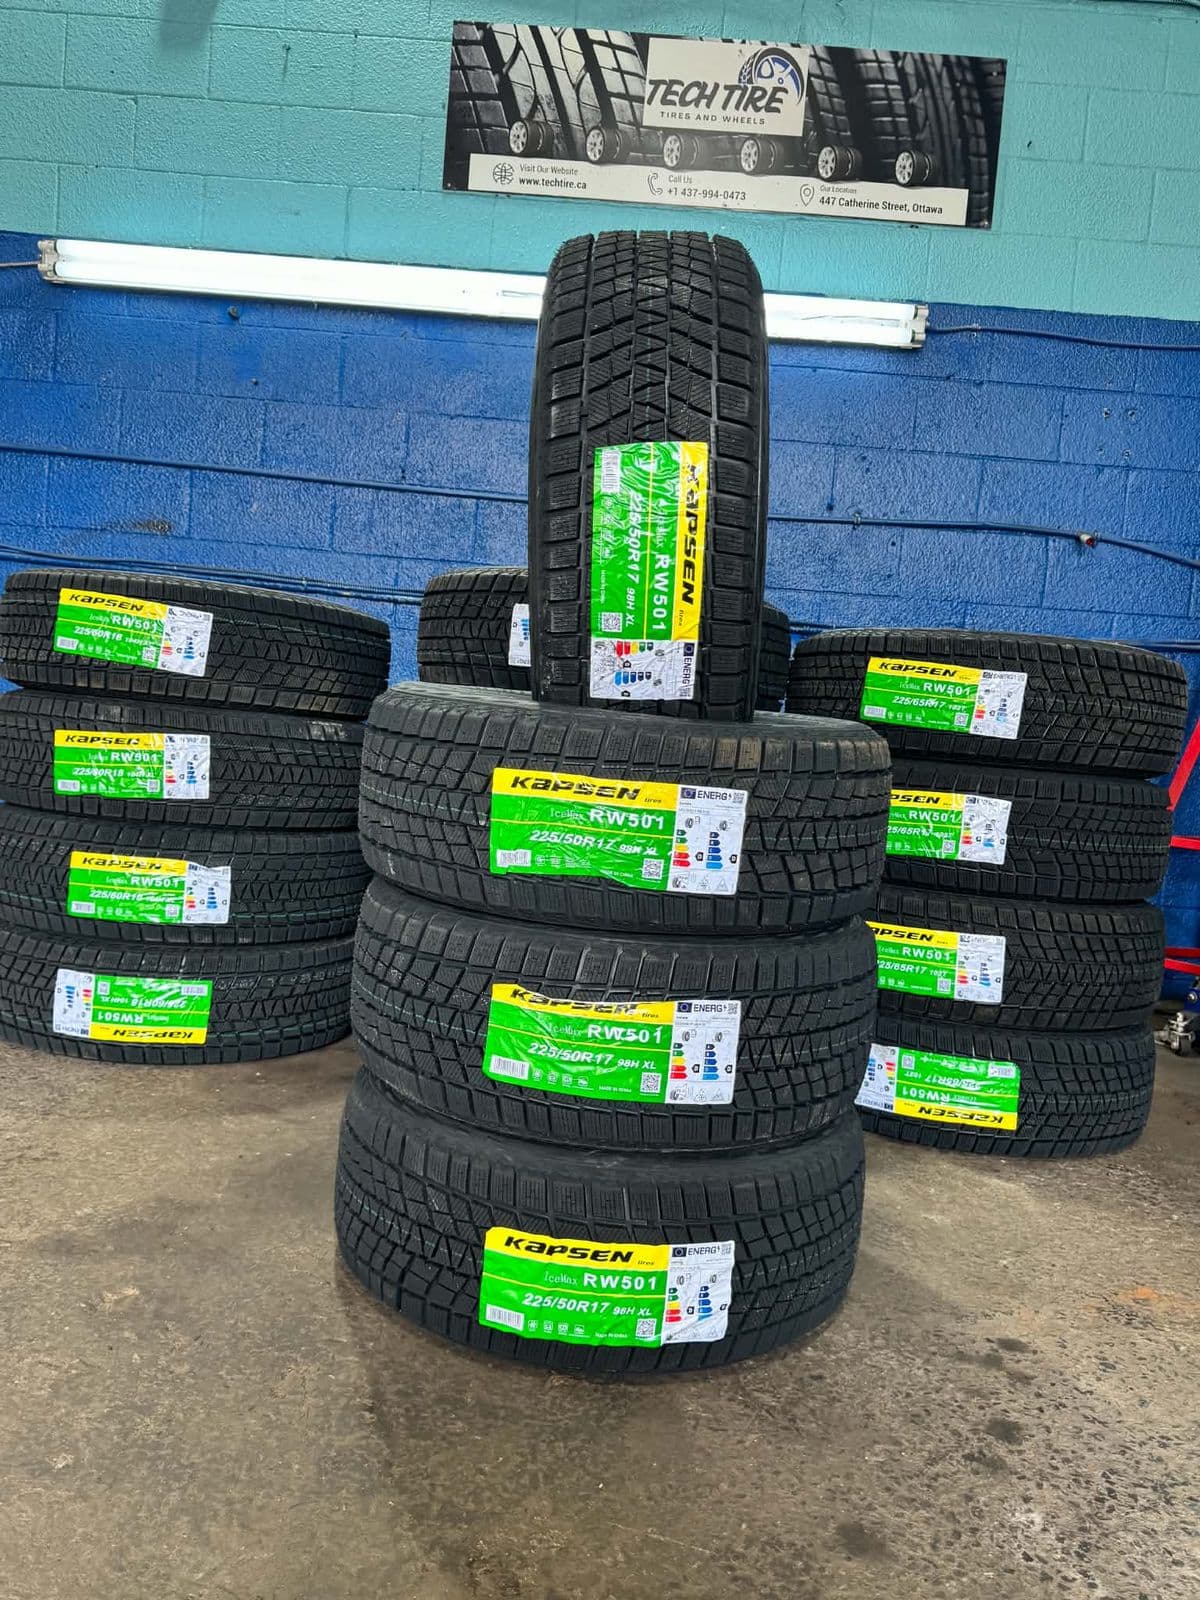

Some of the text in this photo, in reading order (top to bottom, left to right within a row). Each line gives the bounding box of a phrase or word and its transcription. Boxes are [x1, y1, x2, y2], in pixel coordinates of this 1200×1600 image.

[646, 79, 789, 114] TECH TIRE
[660, 111, 766, 125] TIRES AND WHEELS
[520, 164, 578, 175] Visit Our Website
[519, 177, 587, 189] www.techtire.ca
[668, 174, 693, 184] Call Us
[667, 187, 746, 200] +1 437-994-0473
[819, 184, 857, 194] Our Location
[819, 196, 943, 215] 447 Catherine Street, Ottawa
[625, 586, 635, 611] 98H
[652, 553, 670, 632] RW501
[111, 614, 158, 633] RW501
[625, 612, 634, 627] XL
[682, 657, 693, 686] ENERG
[923, 682, 971, 695] RW501
[697, 790, 728, 801] ENERG
[589, 809, 664, 830] RW501
[909, 810, 955, 823] RW501
[130, 877, 180, 888] RW501
[902, 946, 951, 961] RW501
[693, 1004, 723, 1012] ENERG
[98, 1012, 143, 1024] RW501
[587, 1024, 663, 1044] RW501
[527, 1043, 657, 1070] 225/50R17 98H XL
[902, 1086, 950, 1102] RW501
[687, 1247, 717, 1256] ENERG
[543, 1271, 657, 1291] IceMax RW501
[522, 1292, 610, 1314] 225/50R17
[637, 1306, 653, 1317] XL
